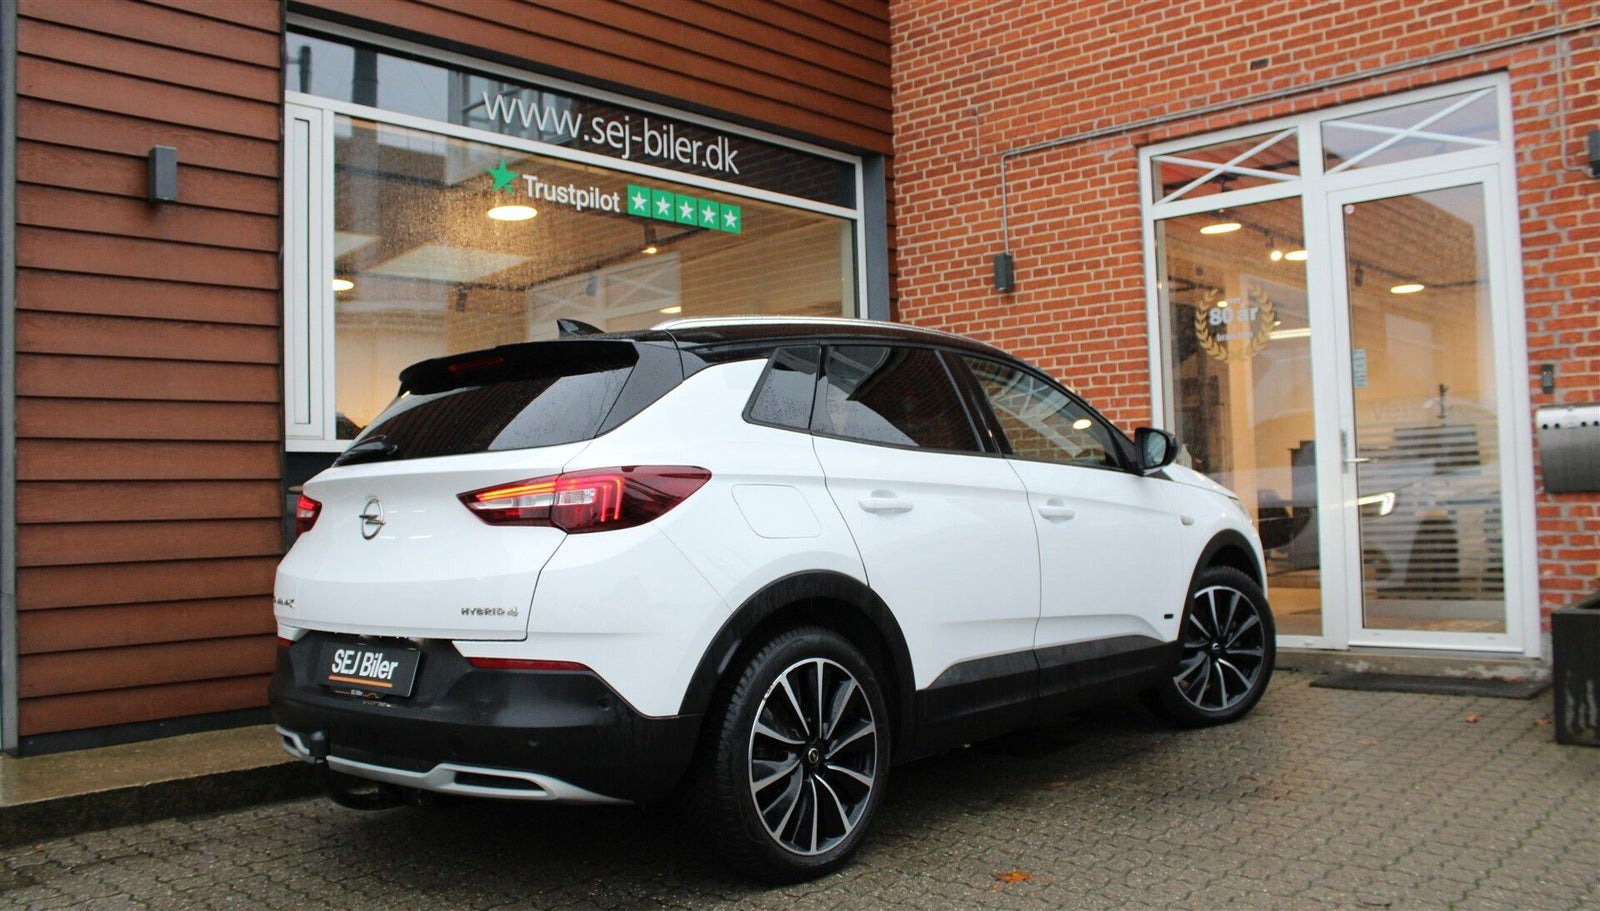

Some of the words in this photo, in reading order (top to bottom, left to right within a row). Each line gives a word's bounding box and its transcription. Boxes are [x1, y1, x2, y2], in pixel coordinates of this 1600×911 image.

[483, 91, 740, 175] www.sej-biler.dk
[522, 174, 621, 212] Trustpilot
[1209, 308, 1234, 326] 80
[331, 648, 361, 674] SEJ
[359, 652, 399, 681] Biler
